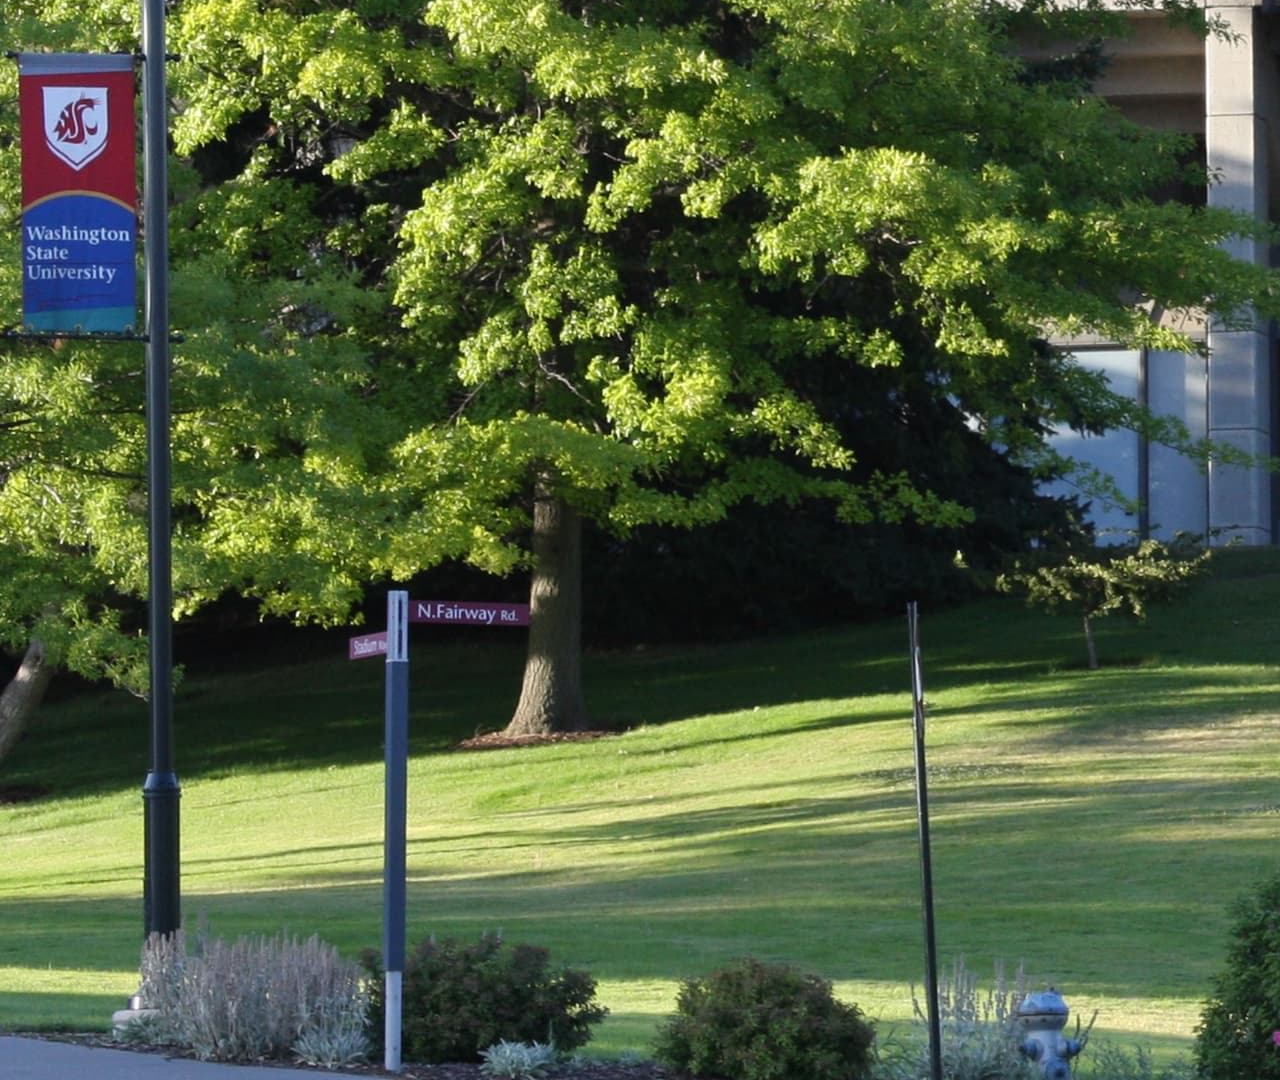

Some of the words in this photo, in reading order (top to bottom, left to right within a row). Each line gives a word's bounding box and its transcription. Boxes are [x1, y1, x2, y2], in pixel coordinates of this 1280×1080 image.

[26, 225, 131, 246] Washington
[26, 245, 69, 261] State
[27, 264, 117, 284] University
[500, 610, 519, 622] Rd.
